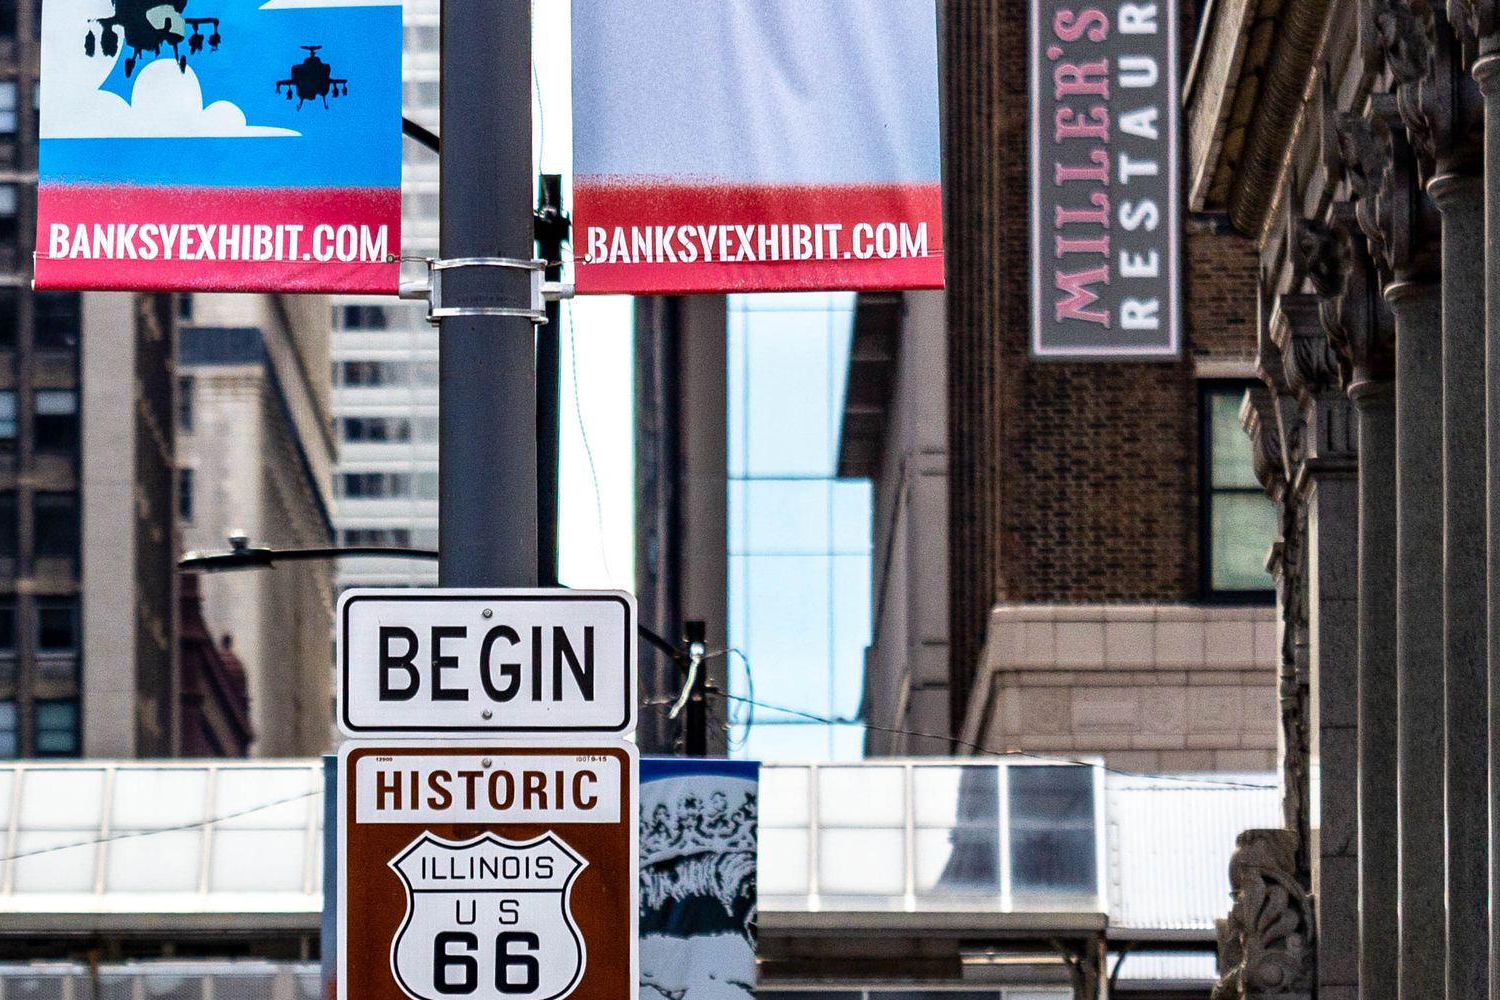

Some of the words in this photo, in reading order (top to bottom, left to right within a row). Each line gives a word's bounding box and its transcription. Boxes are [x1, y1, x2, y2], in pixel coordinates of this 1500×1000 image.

[1054, 8, 1110, 329] MILLER'S
[1119, 1, 1160, 331] RESTAUR
[48, 222, 390, 262] BANKSYEXHIBIT.COM
[586, 221, 930, 265] BANKSYEXHIBIT.COM
[378, 624, 596, 703] BEGIN
[376, 769, 599, 811] HISTORIC
[421, 856, 554, 880] ILLINOIS
[432, 930, 540, 995] 66
